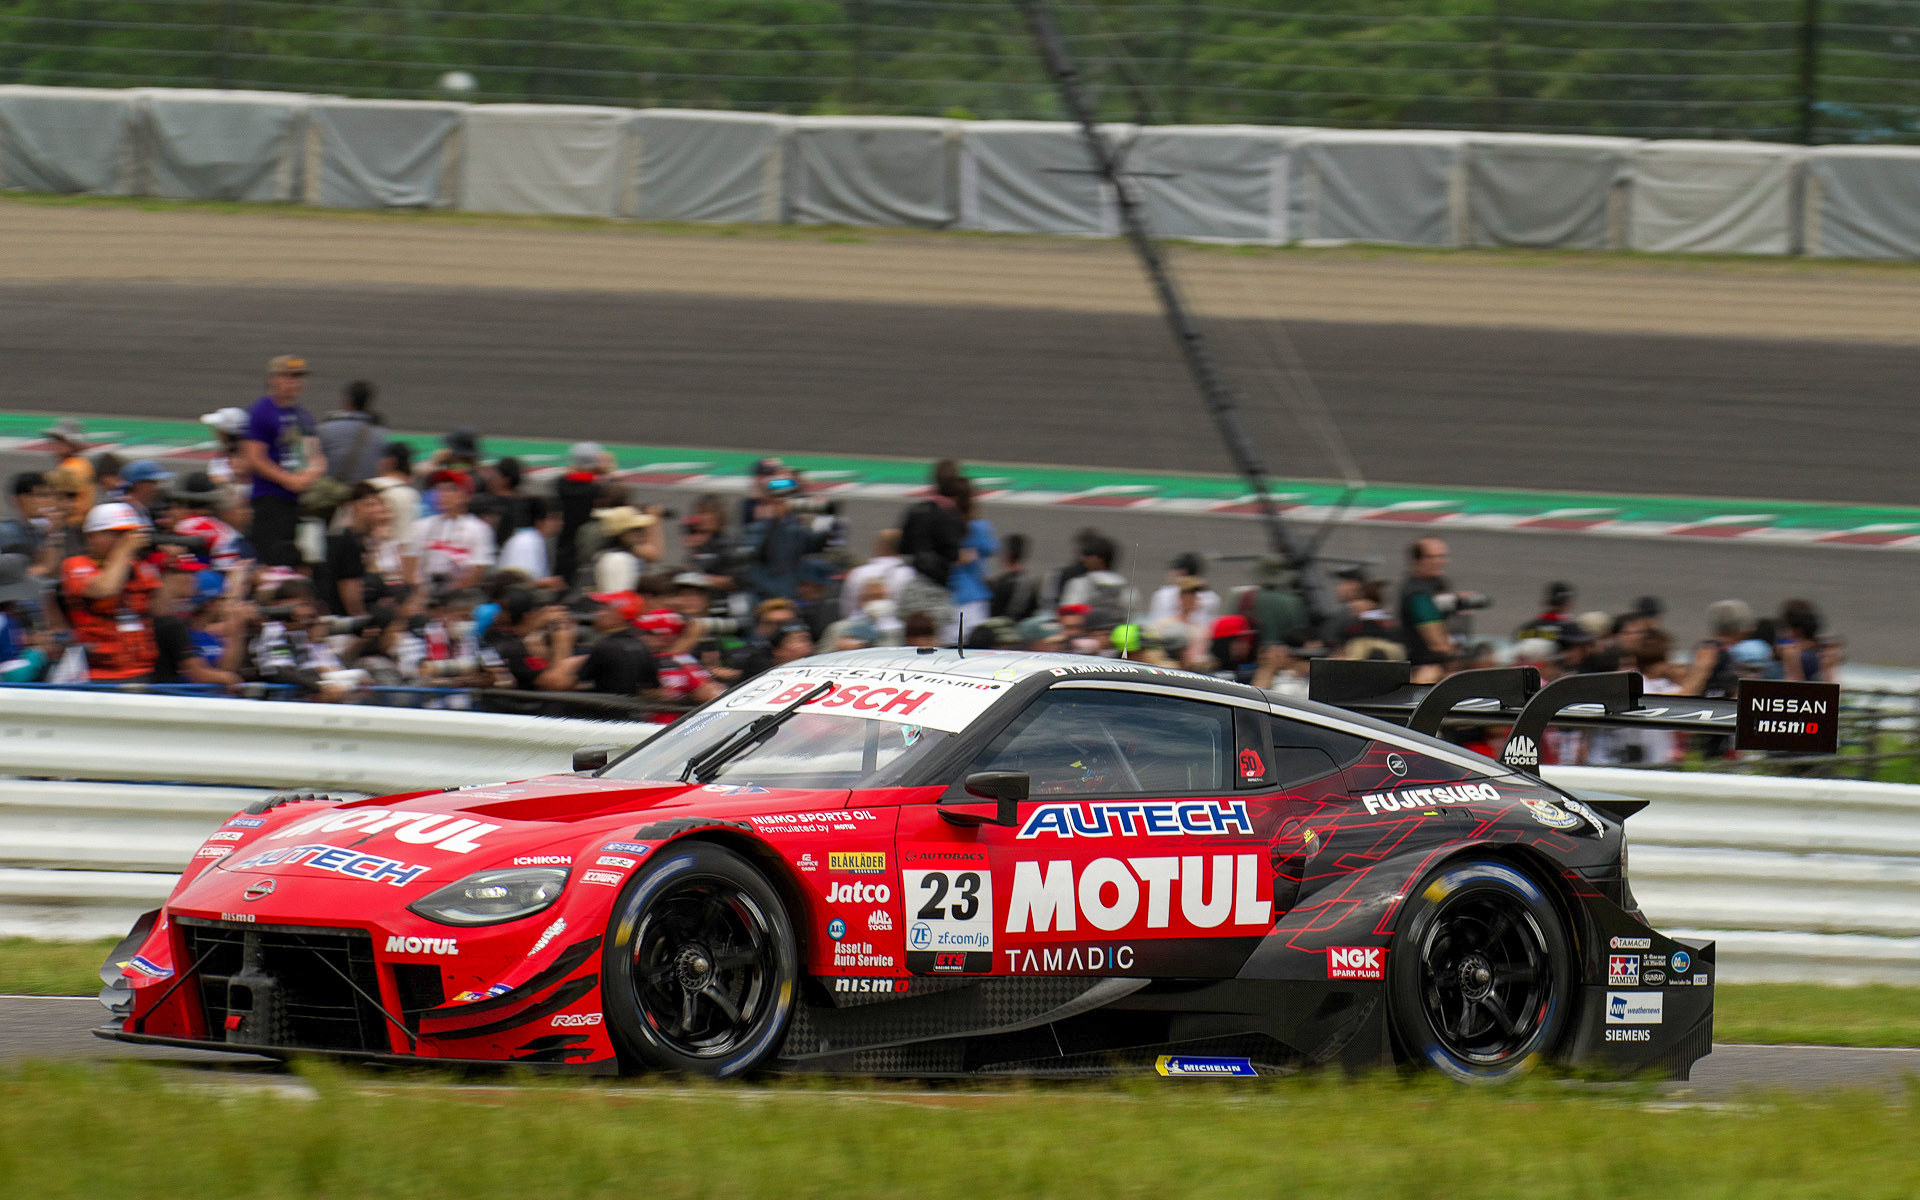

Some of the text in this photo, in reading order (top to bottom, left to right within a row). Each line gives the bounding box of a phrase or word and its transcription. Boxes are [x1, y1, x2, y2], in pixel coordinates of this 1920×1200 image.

[803, 669, 906, 682] NISSAN
[766, 683, 935, 716] BOSCH
[1752, 698, 1827, 714] NISSAN
[1758, 720, 1819, 734] nismo
[1504, 735, 1538, 757] MAC
[1504, 756, 1538, 766] TOOLS
[1362, 783, 1501, 816] FUJITSUBO
[751, 810, 877, 825] NISMO SPORTS OIL
[1016, 800, 1254, 839] AUTECH
[269, 808, 503, 854] MOTUL
[758, 823, 817, 834] Formulated
[816, 824, 830, 833] by
[217, 842, 432, 888] AUTECH
[514, 856, 572, 865] ICHIKOH
[831, 853, 884, 868] BLÅKLÄDER
[826, 880, 890, 904] Jatco
[917, 871, 981, 921] 23
[1006, 854, 1272, 933] MOTUL
[868, 910, 892, 925] MAC
[912, 928, 930, 944] ZF
[938, 932, 990, 947] zf.com/jp
[1619, 939, 1650, 947] TAMACHI
[384, 936, 460, 956] MOTUL
[834, 942, 872, 954] Asset in
[834, 954, 894, 966] Auto Service
[1005, 945, 1135, 972] TAMADIC
[1331, 948, 1380, 969] NGK
[1332, 969, 1380, 978] SPARK PLUGS
[1610, 976, 1638, 984] TAMIYA
[834, 978, 910, 992] nismo
[1627, 1006, 1660, 1014] weathernews
[551, 1013, 604, 1026] RAYS
[1606, 1030, 1650, 1042] SIEMENS
[1184, 1064, 1241, 1072] MICHELIN
